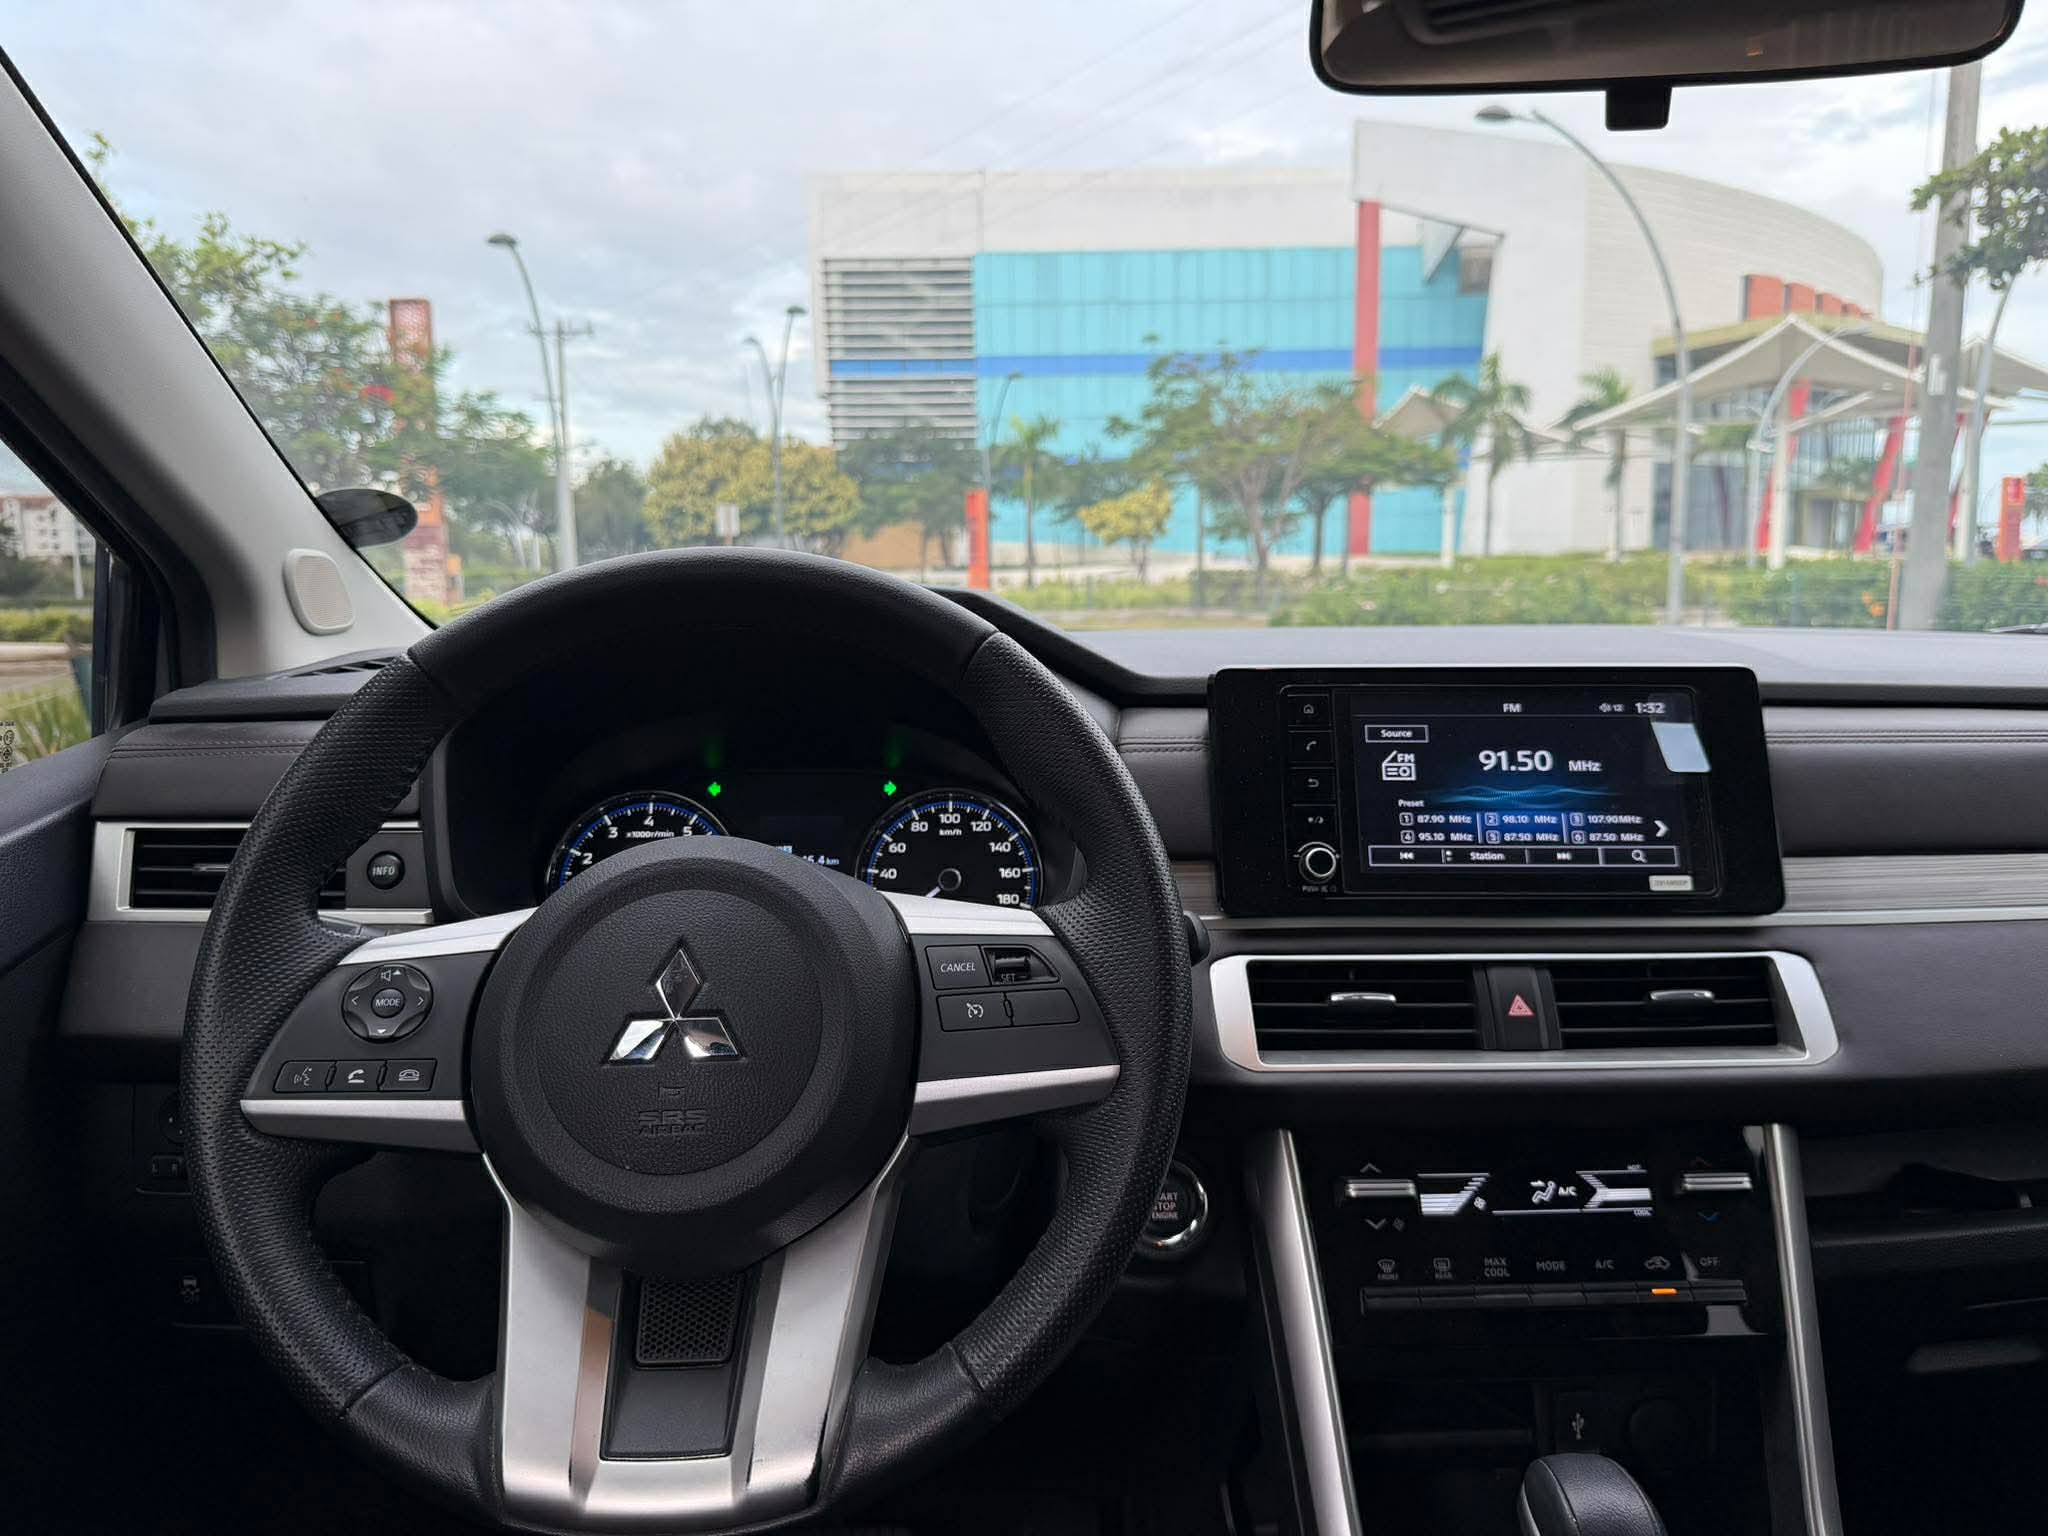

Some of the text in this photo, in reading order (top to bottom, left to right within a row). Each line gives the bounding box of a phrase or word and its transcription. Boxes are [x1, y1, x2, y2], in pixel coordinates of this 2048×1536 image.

[1502, 703, 1522, 713] FM
[1634, 702, 1666, 714] 1:32
[1380, 729, 1413, 738] Source
[1397, 753, 1415, 763] FM
[1478, 750, 1602, 772] 91.50 MHz
[1398, 799, 1425, 808] Preset
[643, 816, 654, 827] 4
[938, 814, 961, 824] 100
[1448, 815, 1472, 824] MHz
[1534, 815, 1558, 824] MHz
[682, 826, 692, 837] 5
[911, 822, 929, 832] 80
[970, 821, 992, 832] 120
[608, 826, 618, 838] 3
[1449, 833, 1474, 842] MHz
[1535, 833, 1559, 842] MHz
[1620, 833, 1645, 842] MHz
[888, 843, 906, 853] 60
[989, 843, 1012, 853] 140
[583, 853, 593, 865] 2
[1469, 851, 1505, 861] Station
[372, 866, 395, 876] INFO
[880, 868, 898, 879] 40
[998, 868, 1021, 879] 160
[996, 894, 1020, 905] 180
[940, 962, 976, 973] CANCEL
[375, 997, 401, 1007] MODE
[1558, 1185, 1578, 1197] A/C
[1483, 1257, 1506, 1266] MAX
[1535, 1260, 1568, 1272] MODE
[1595, 1259, 1616, 1270] A/C
[1699, 1256, 1719, 1267] OFF
[1483, 1267, 1511, 1278] COOL
